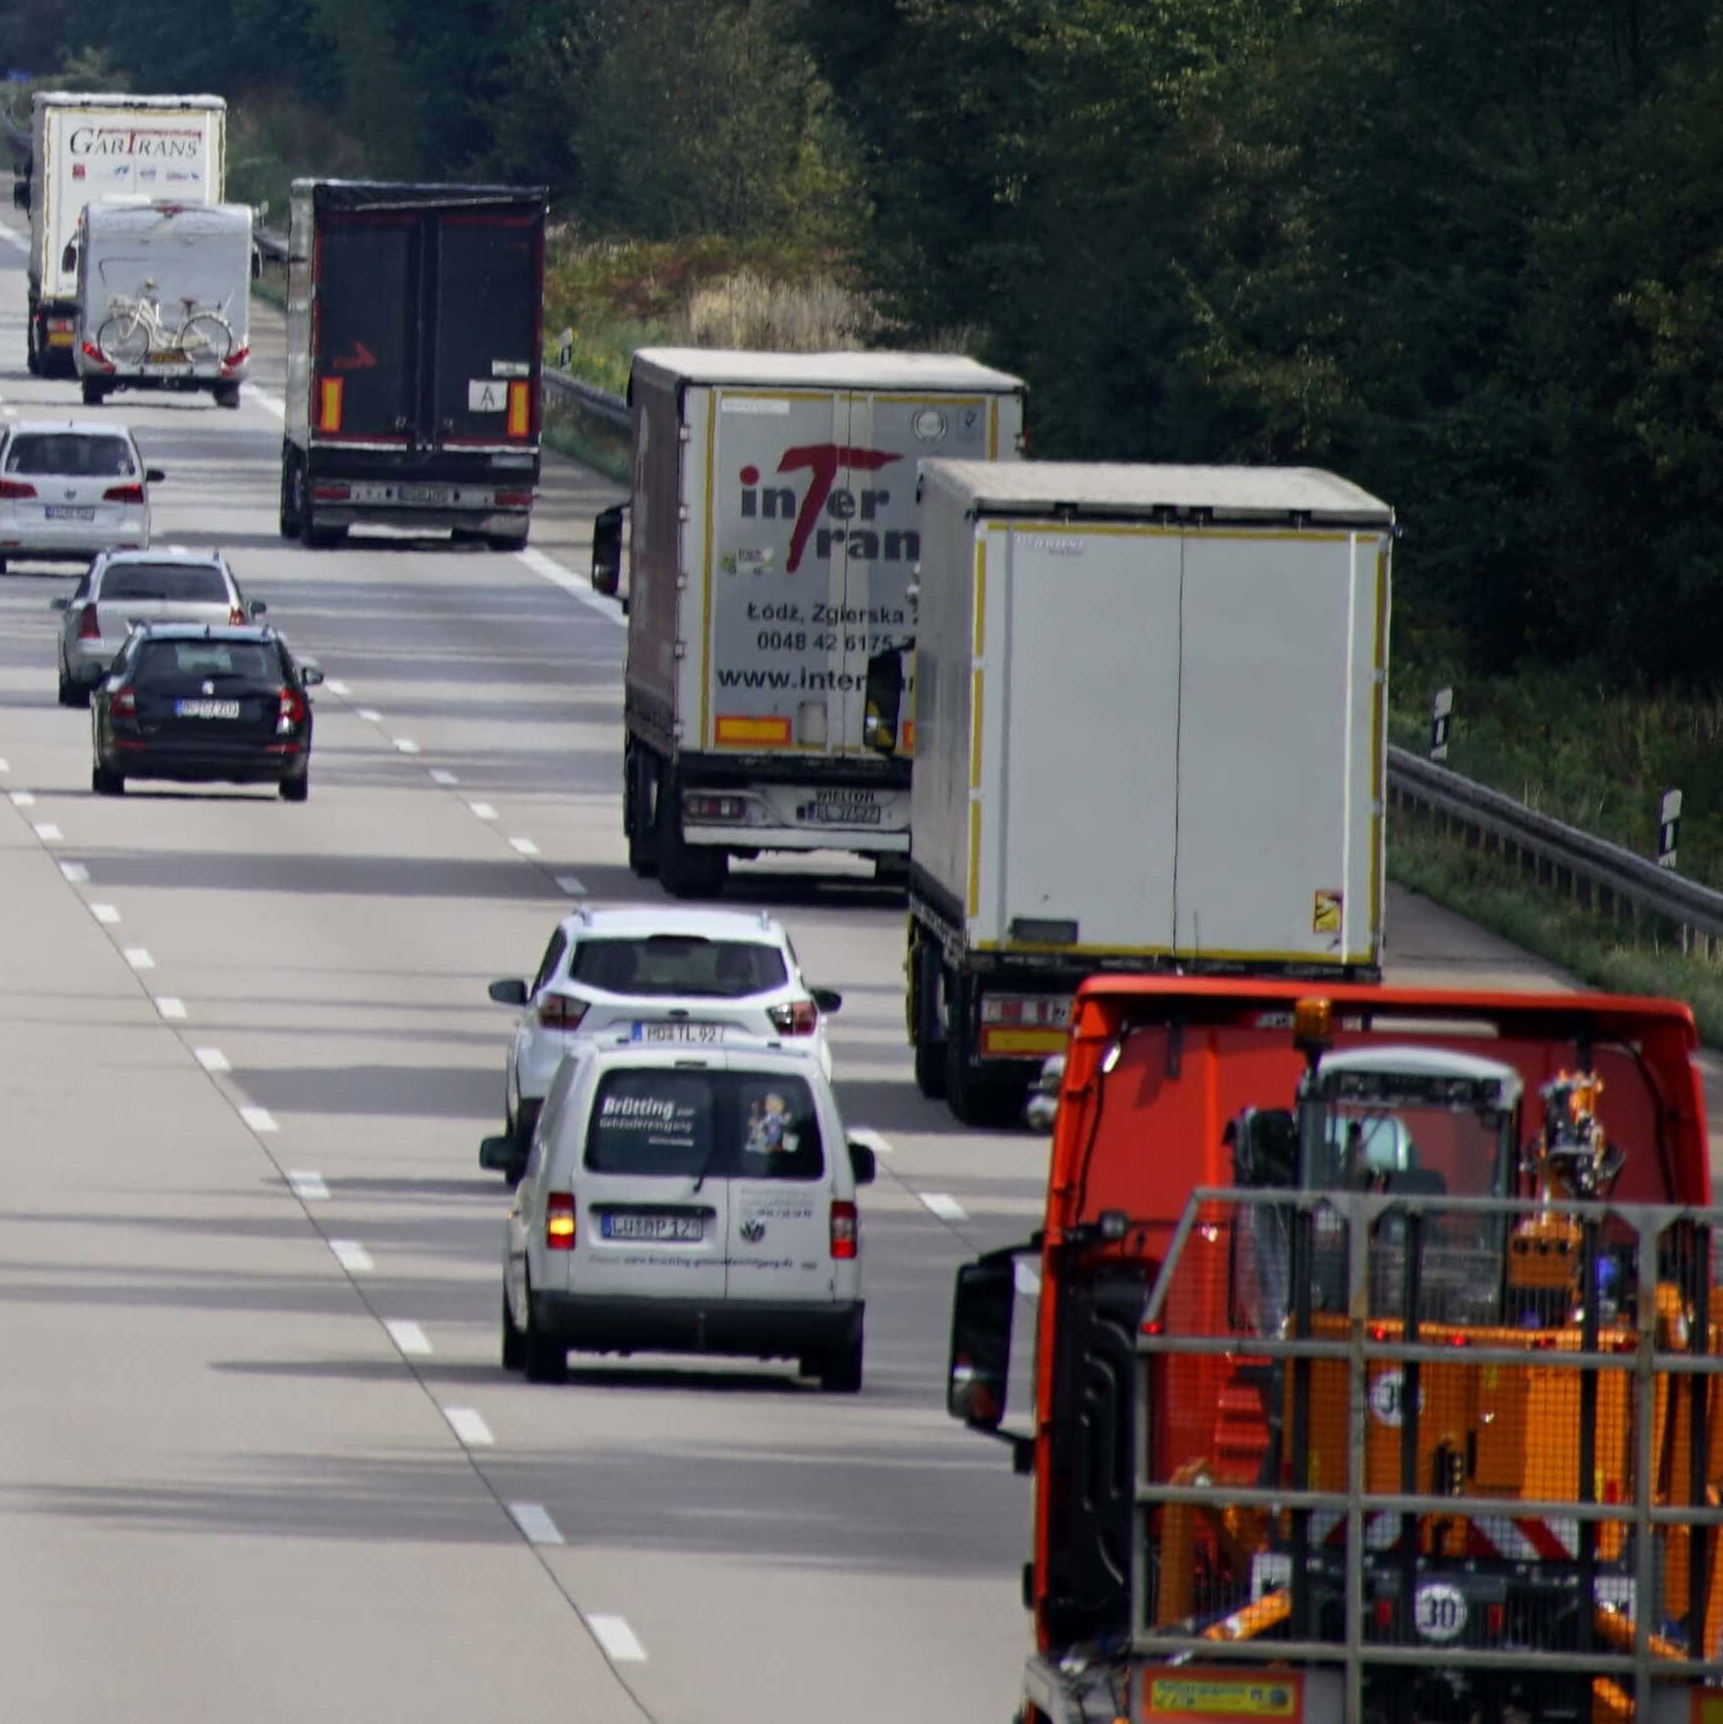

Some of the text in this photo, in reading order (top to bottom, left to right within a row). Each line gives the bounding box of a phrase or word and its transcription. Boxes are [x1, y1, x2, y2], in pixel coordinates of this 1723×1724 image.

[811, 604, 904, 627] Zgierska
[757, 632, 806, 651] 0048
[813, 633, 837, 651] 42
[602, 1096, 674, 1121] Brütting
[1422, 1597, 1456, 1627] 30
